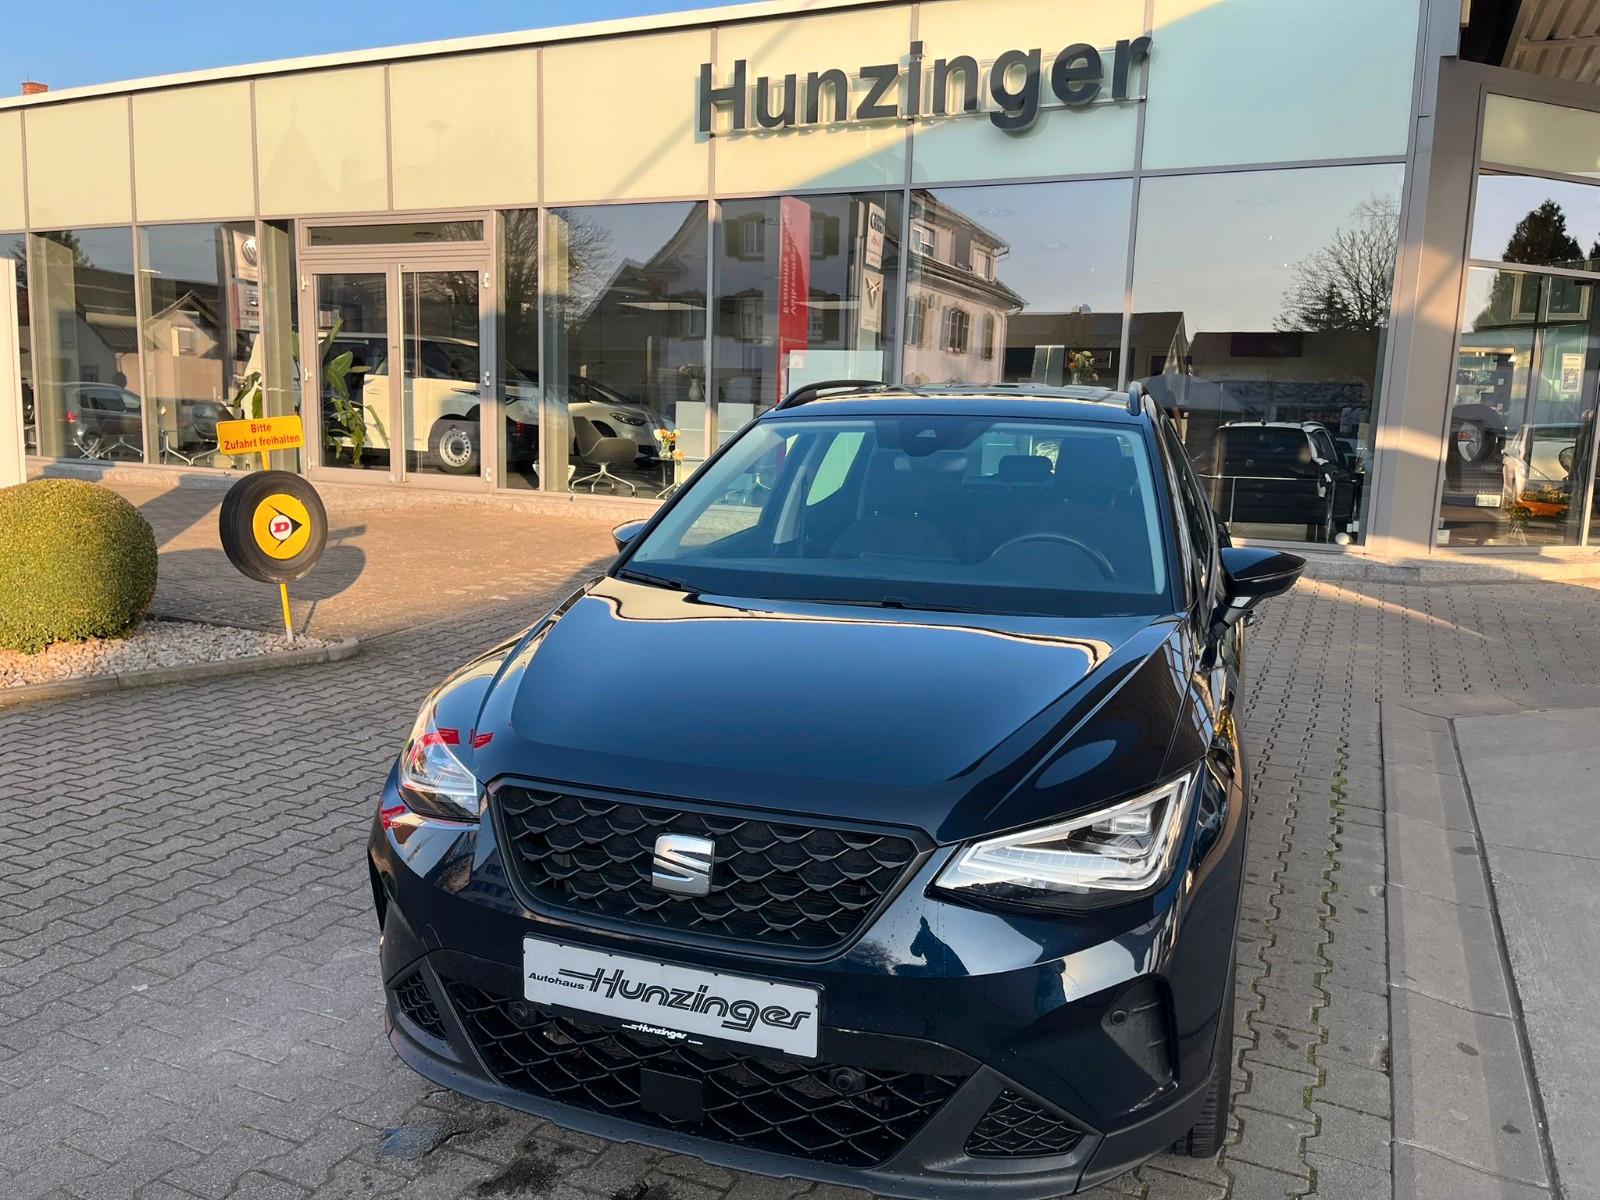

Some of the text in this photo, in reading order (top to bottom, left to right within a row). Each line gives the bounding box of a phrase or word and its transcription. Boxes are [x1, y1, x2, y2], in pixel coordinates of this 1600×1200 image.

[699, 37, 1153, 132] Hunzinger
[250, 423, 272, 434] Bitte
[224, 434, 300, 451] Zufahrt freihalten
[273, 521, 290, 533] D
[528, 967, 811, 1033] Autohaus Hunzinger
[631, 1023, 688, 1040] Hunzinger
